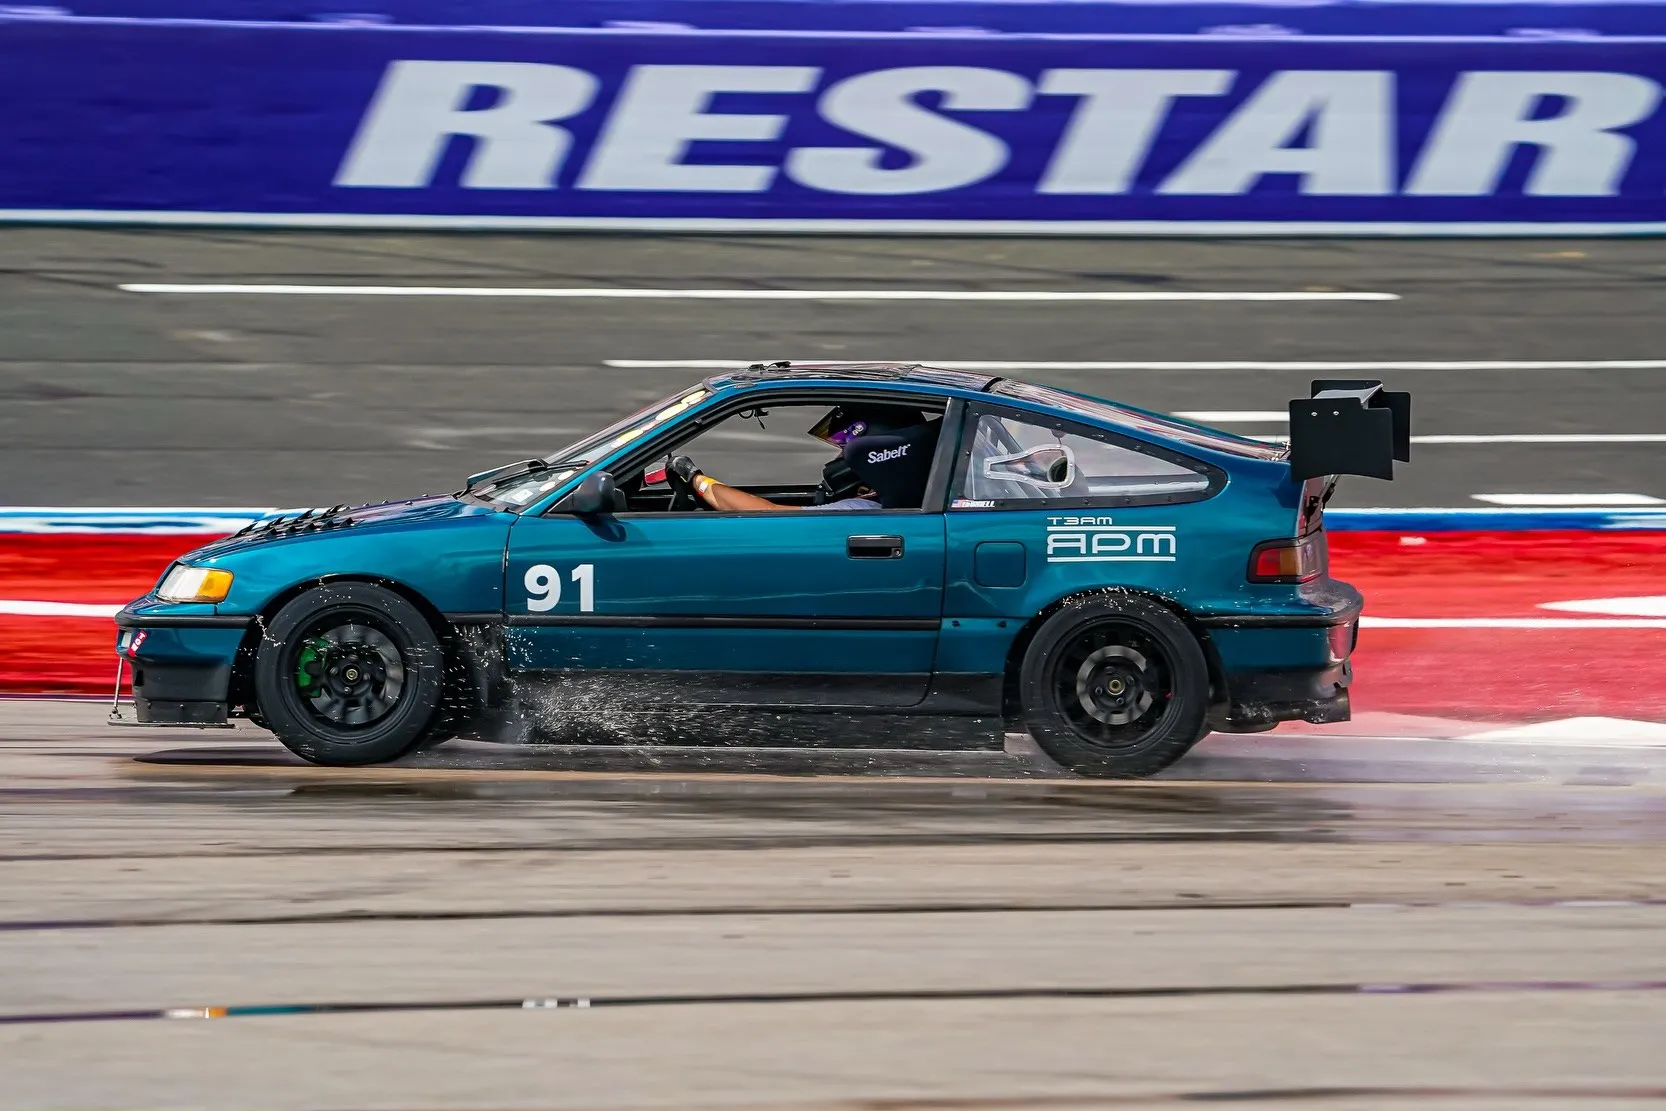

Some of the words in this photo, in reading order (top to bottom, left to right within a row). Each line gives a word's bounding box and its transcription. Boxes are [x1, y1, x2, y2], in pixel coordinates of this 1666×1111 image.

[333, 59, 1666, 197] RESTAR
[867, 444, 911, 464] Sabelt
[524, 564, 594, 612] 91
